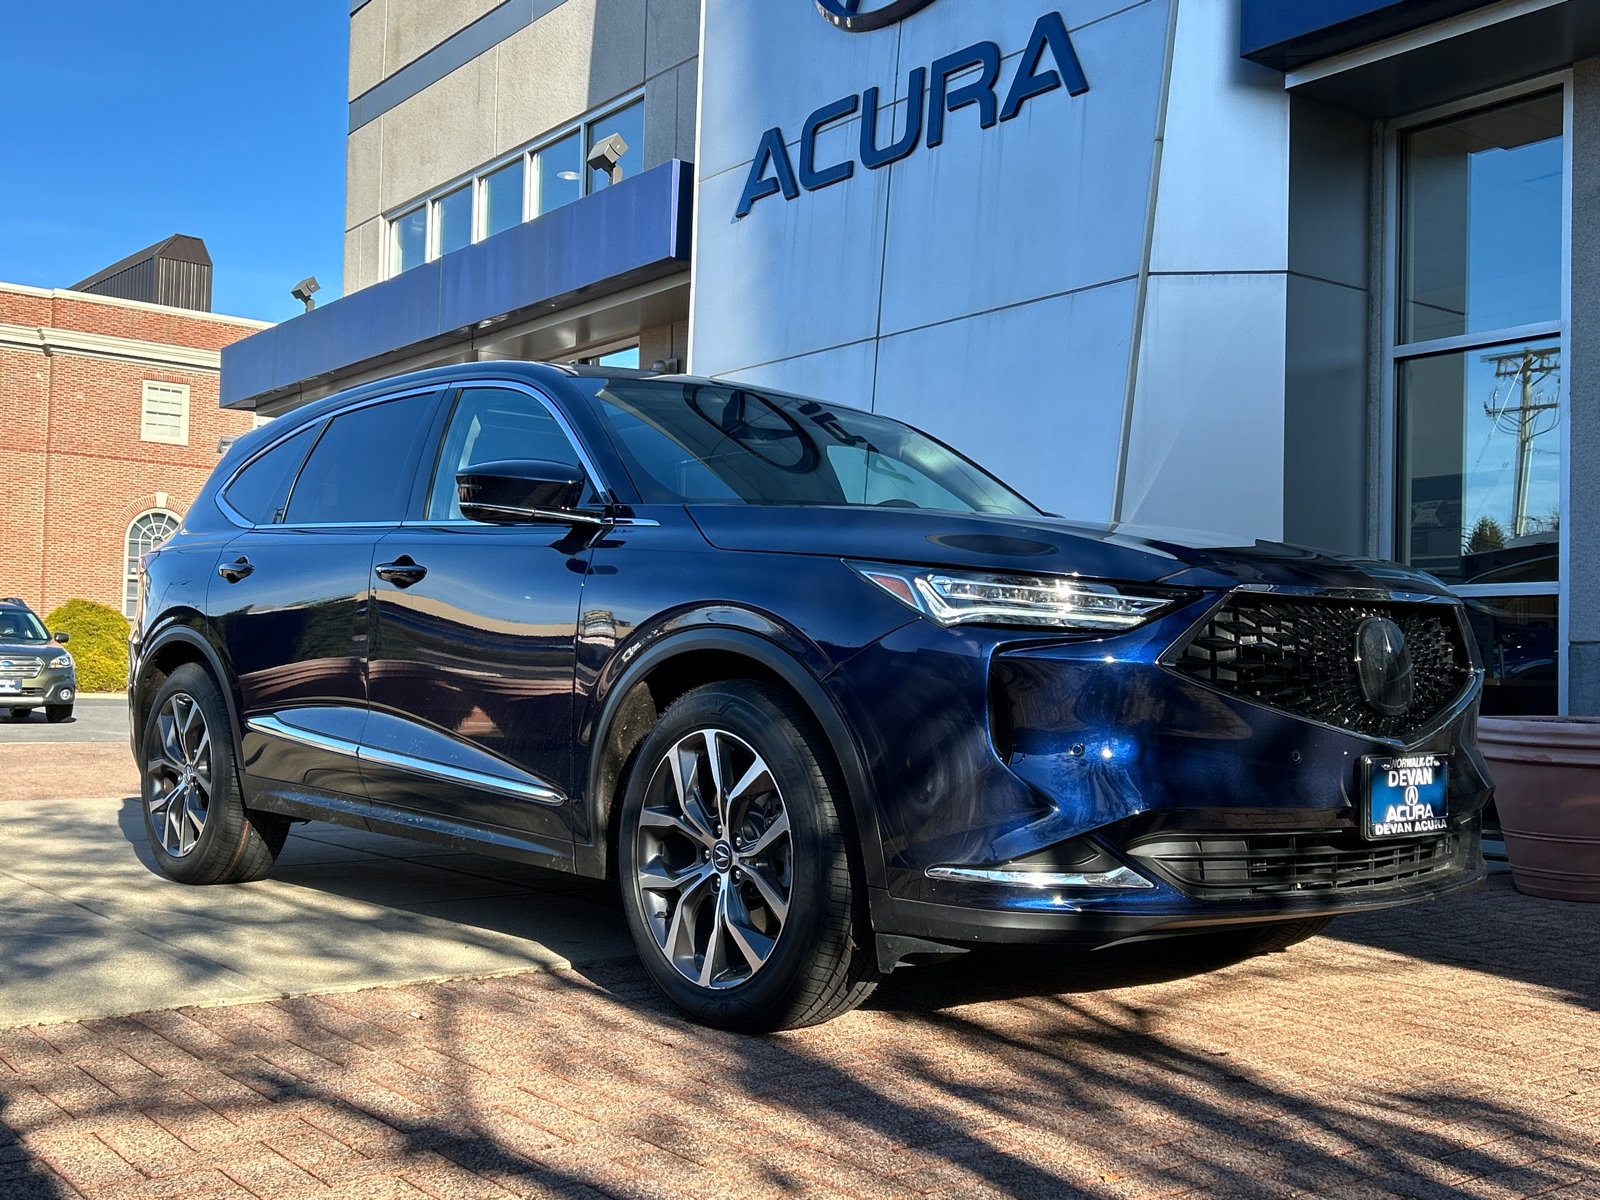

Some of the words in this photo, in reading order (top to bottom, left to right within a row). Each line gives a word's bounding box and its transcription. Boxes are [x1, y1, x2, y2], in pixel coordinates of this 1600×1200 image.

[734, 11, 1090, 220] ACURA
[1426, 756, 1434, 767] CT
[1388, 768, 1432, 787] DEVAN
[1385, 804, 1434, 823] ACURA
[1375, 822, 1413, 836] DEVAN
[1414, 819, 1447, 832] ACURA
